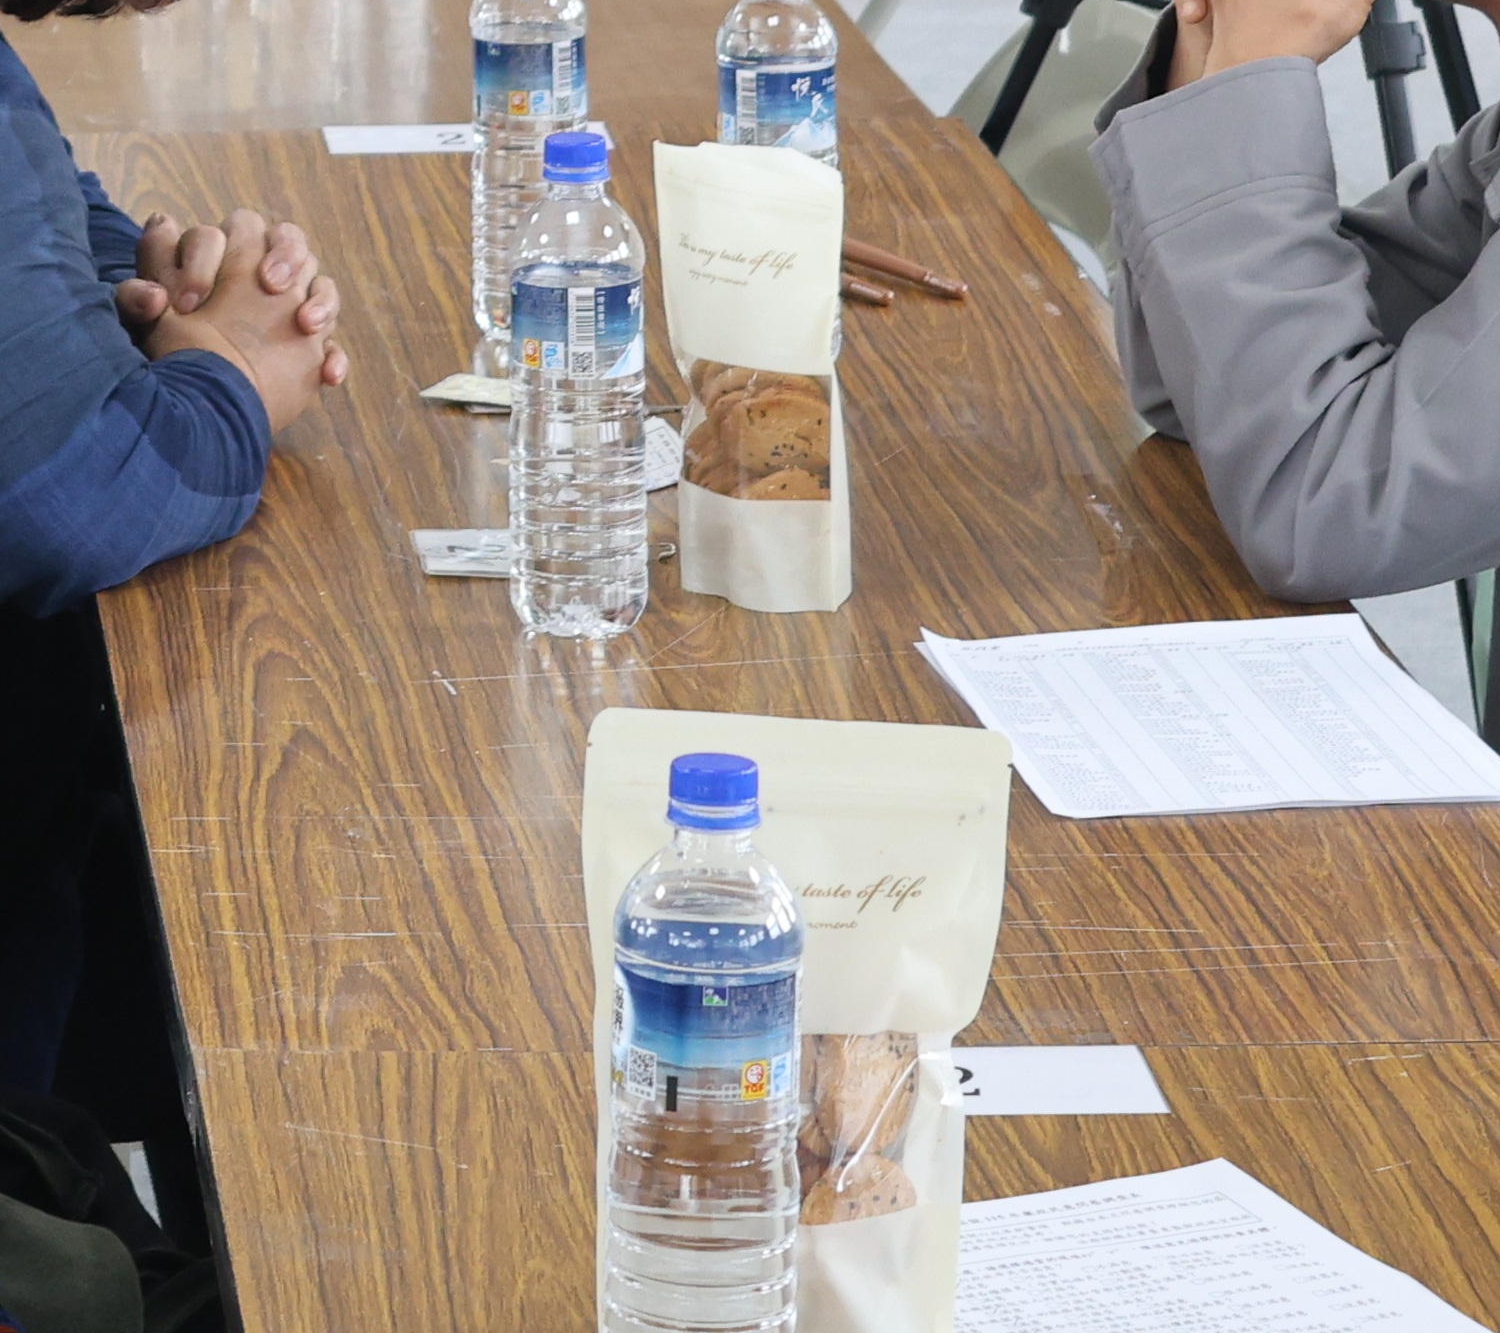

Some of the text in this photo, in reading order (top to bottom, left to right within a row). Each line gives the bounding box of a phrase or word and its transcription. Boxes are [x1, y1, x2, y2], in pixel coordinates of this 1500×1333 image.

[436, 131, 467, 146] 2
[801, 874, 927, 914] taste of life
